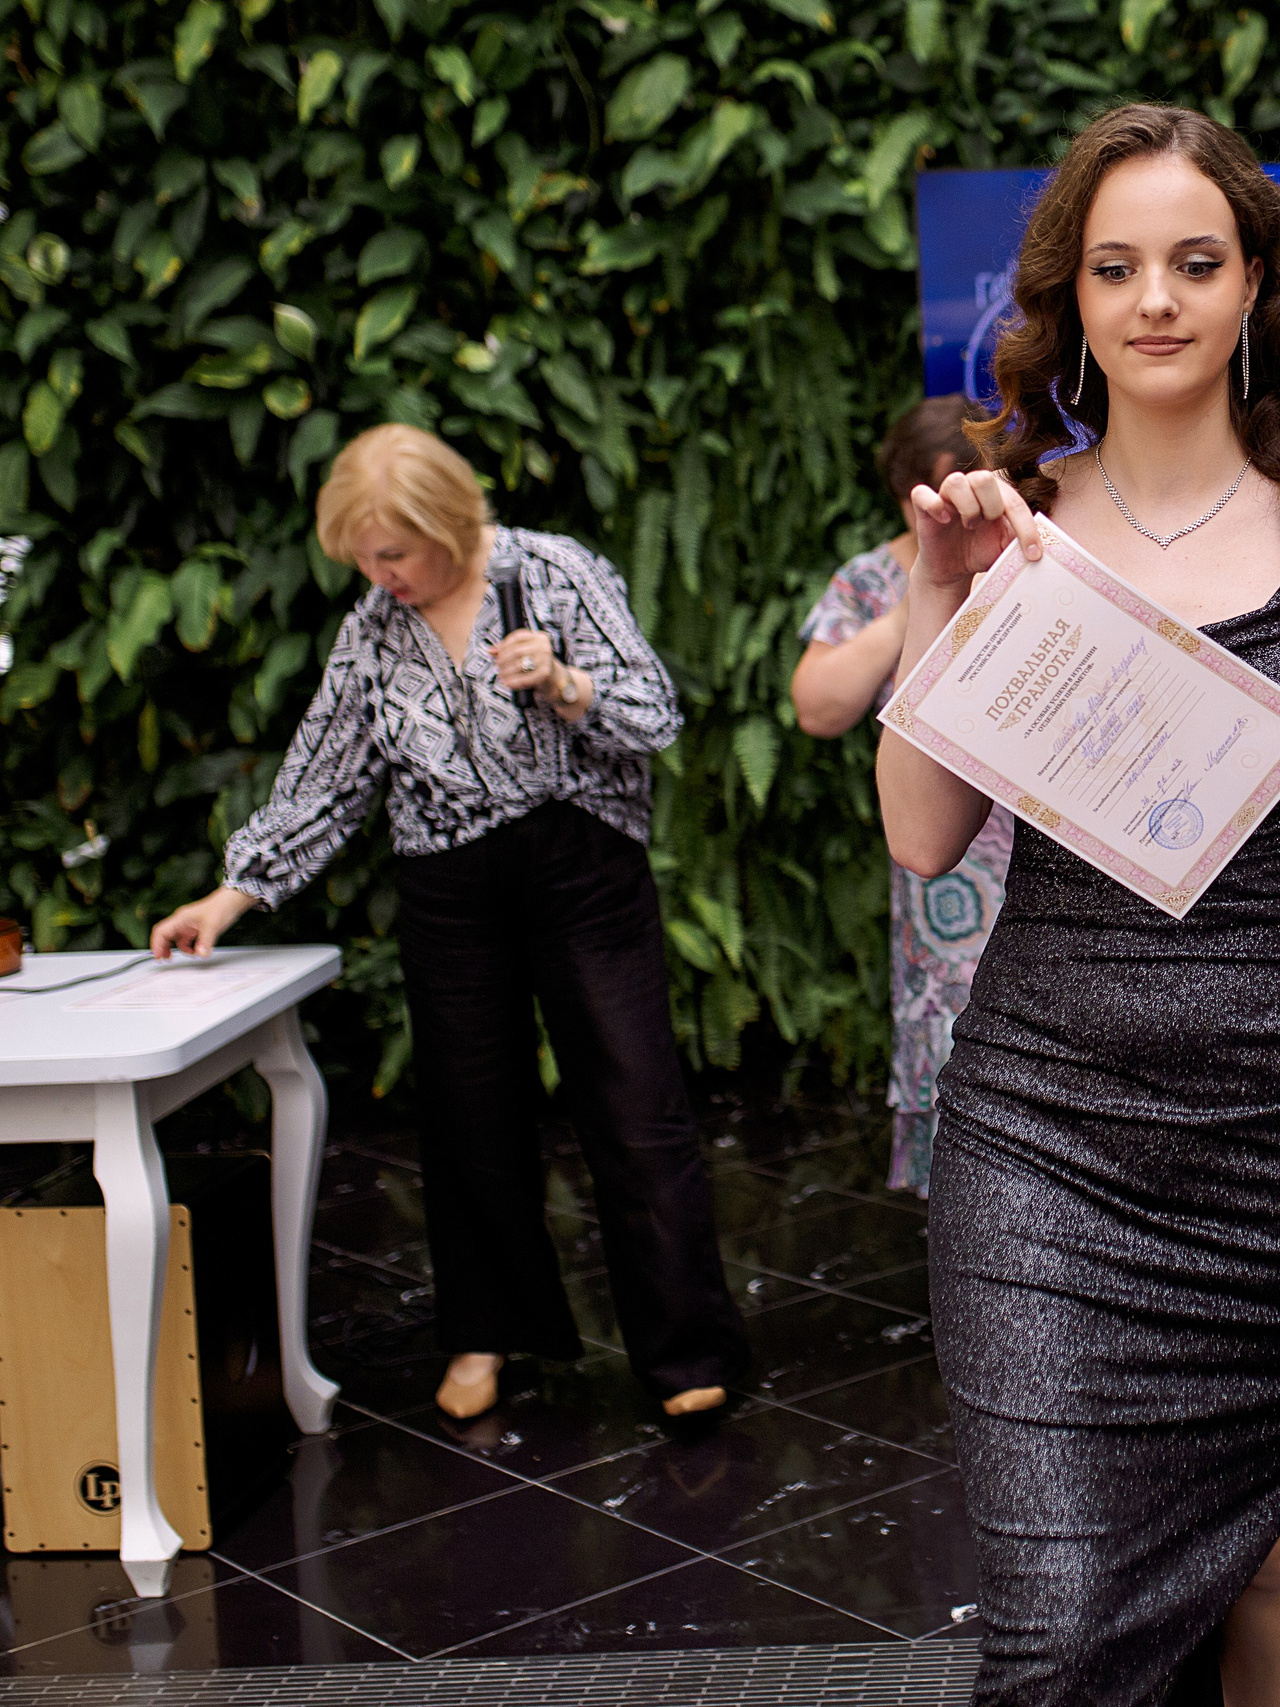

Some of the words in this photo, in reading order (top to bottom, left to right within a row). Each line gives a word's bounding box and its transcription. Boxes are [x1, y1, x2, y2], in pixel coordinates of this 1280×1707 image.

[957, 641, 991, 682] МИНИСТЕРСТВО
[989, 602, 1021, 642] ПРОСВЕЩЕНИЯ
[968, 644, 998, 680] РОССИЙСКОЙ
[996, 613, 1022, 645] ФЕДЕРАЦИИ
[984, 618, 1070, 721] ПОХВАЛЬНАЯ
[1013, 648, 1075, 717] ГРАМОТА
[1030, 704, 1051, 728] ОСОБЫЕ
[1048, 681, 1069, 704] УСПЕХИ
[1070, 645, 1097, 677] ИЗУЧЕНИИ
[1037, 697, 1066, 732] ОТДЕЛЬНЫХ
